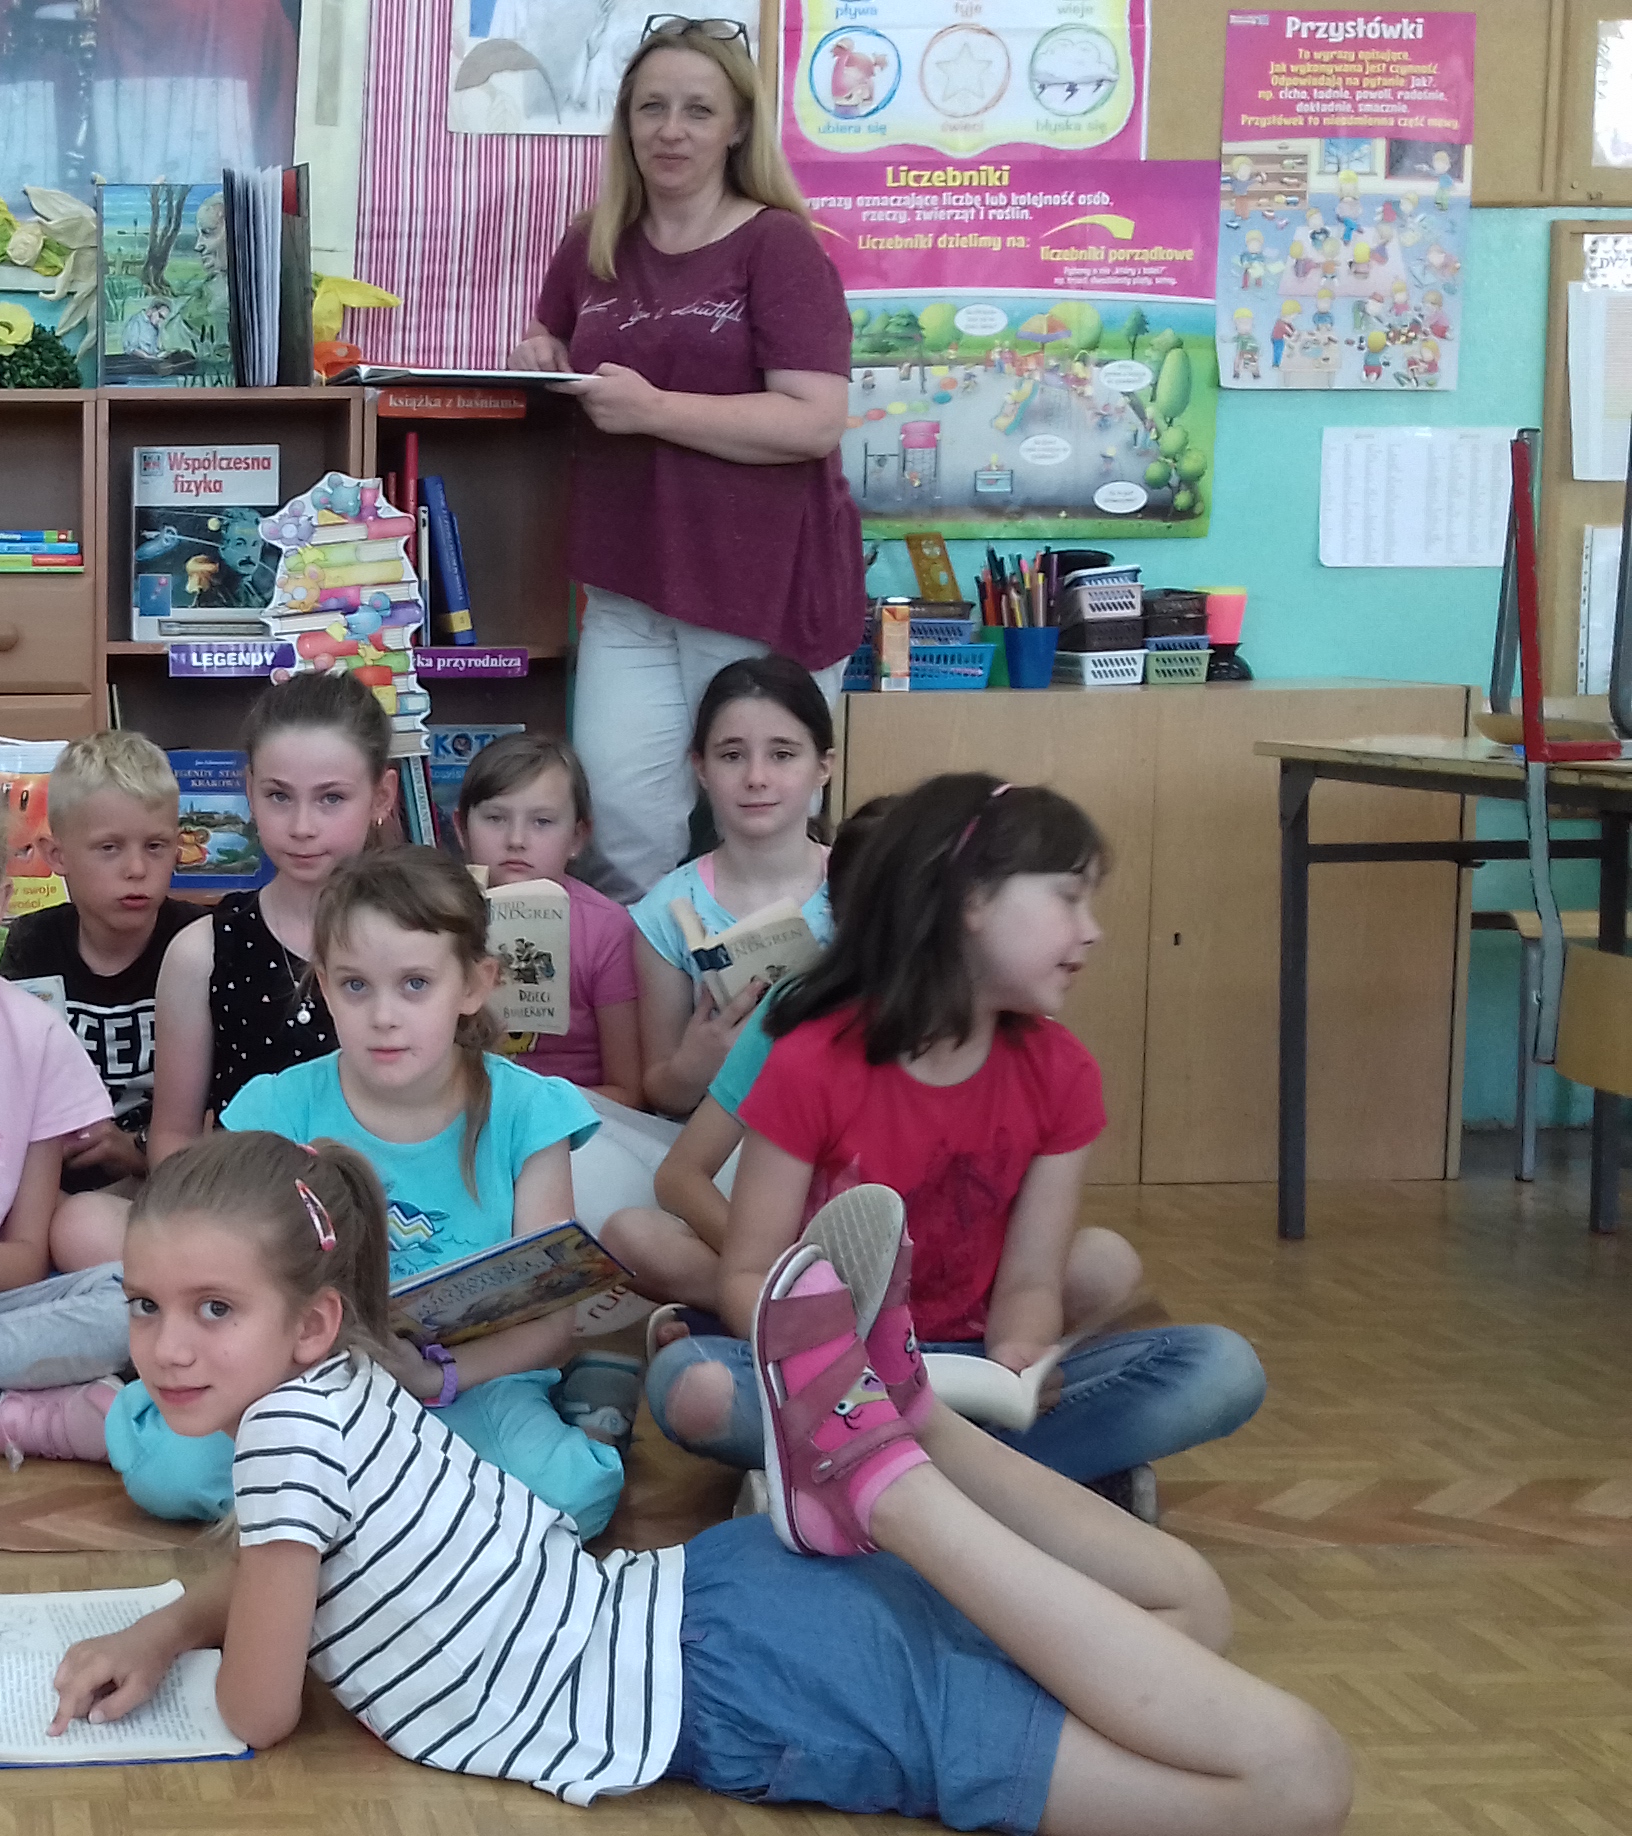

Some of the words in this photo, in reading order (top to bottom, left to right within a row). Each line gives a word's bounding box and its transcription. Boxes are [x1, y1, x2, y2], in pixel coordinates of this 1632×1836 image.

[1285, 16, 1425, 43] Przysłówki
[885, 165, 1011, 188] Liczebniki
[856, 193, 939, 209] oznaczające
[942, 191, 982, 209] liczbę
[985, 191, 1008, 207] lub
[1011, 191, 1075, 209] kolejność
[858, 233, 933, 250] Liczebniki
[937, 233, 1003, 251] dzielimy
[1108, 246, 1194, 264] porządkowe
[168, 451, 272, 475] Współczesna
[173, 474, 224, 497] fizyka
[192, 651, 276, 667] LEGENDY
[436, 653, 522, 672] przyrodnicza
[433, 733, 498, 758] KOT
[490, 908, 563, 920] INDGREN
